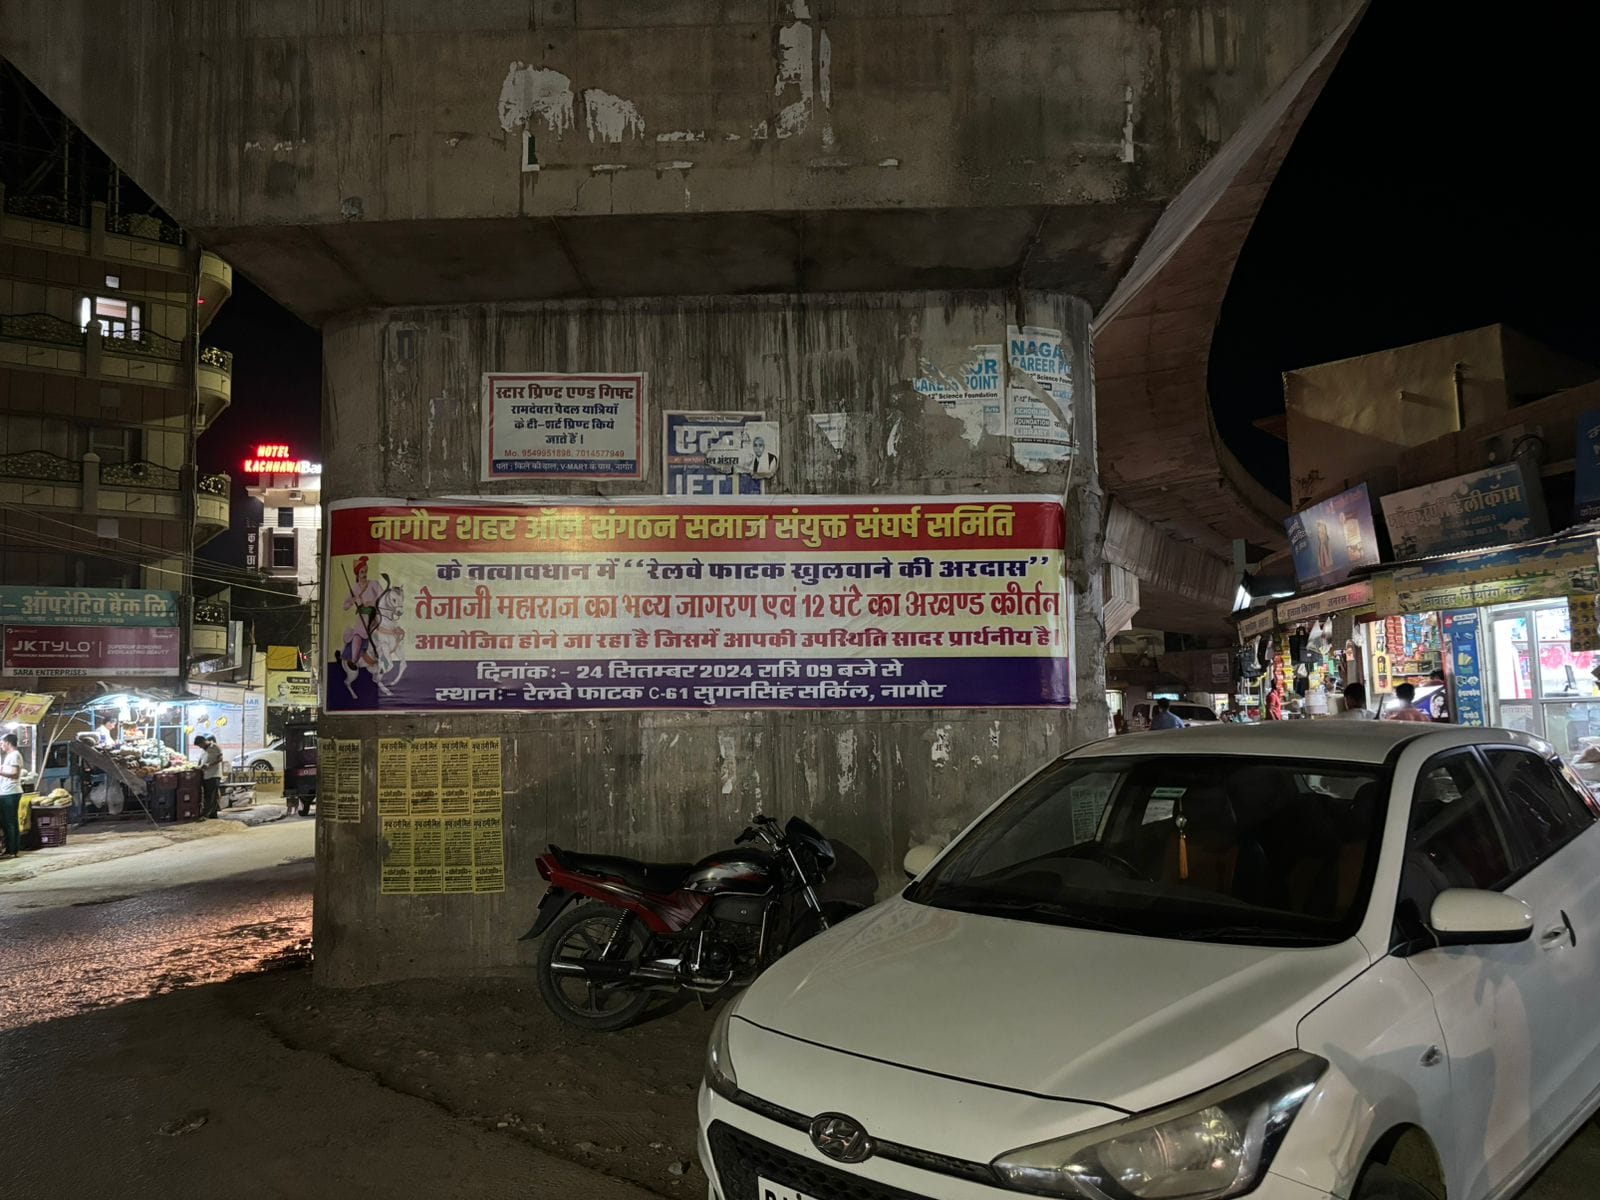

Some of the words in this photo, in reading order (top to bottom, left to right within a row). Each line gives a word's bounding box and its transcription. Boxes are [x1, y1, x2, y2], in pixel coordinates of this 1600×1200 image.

[1037, 374, 1058, 382] Science
[495, 386, 526, 399] स्टार
[566, 386, 597, 399] एण्ड
[598, 384, 635, 400] गिफ्ट
[511, 403, 553, 415] रामदेवरा
[554, 402, 580, 415] पैदल
[514, 418, 525, 429] के
[1014, 418, 1050, 426] FOUNDATION
[545, 433, 567, 445] जाते
[257, 445, 290, 458] HOTEL
[369, 508, 449, 541] नागौर
[455, 514, 519, 541] शहर
[525, 508, 586, 541] ऑल
[590, 508, 680, 540] संगठन
[684, 514, 768, 540] समाज
[773, 507, 850, 548] संयुक्त
[853, 506, 923, 540] संघर्ष
[925, 504, 1016, 539] समिति
[436, 558, 463, 581] के
[467, 562, 591, 581] तत्वावधान
[596, 557, 620, 580] में
[709, 561, 785, 580] फाटक
[790, 557, 895, 585] खुलवाने
[899, 556, 933, 579] की
[108, 592, 141, 617] बैंक
[144, 593, 175, 618] लि.
[414, 585, 491, 621] तेजाजी
[496, 594, 581, 620] महाराज
[584, 594, 619, 619] का
[622, 593, 670, 619] भव्य
[675, 593, 758, 619] जागरण
[761, 587, 798, 619] एवं
[802, 594, 825, 618] 12
[829, 584, 864, 617] घंटे
[867, 593, 901, 617] का
[905, 592, 986, 616] अखण्ड
[990, 580, 1060, 617] कीर्तन
[13, 640, 91, 652] JKTYLO
[414, 629, 513, 650] आयोजित
[518, 628, 560, 650] होने
[563, 632, 596, 650] जा
[599, 631, 632, 649] रहा
[635, 627, 651, 649] है
[654, 627, 721, 649] जिसमें
[723, 627, 798, 648] आपकी
[801, 627, 887, 647] उपस्थिति
[891, 631, 944, 647] सादर
[948, 627, 1034, 646] प्रार्थनीय
[576, 666, 604, 679] 24
[608, 660, 696, 679] सितम्बर
[697, 664, 753, 678] 2024
[757, 658, 803, 679] रात्रि
[806, 664, 831, 678] 09
[836, 659, 880, 678] बजे
[881, 658, 905, 678] से
[522, 682, 573, 702] रेलवे
[577, 685, 644, 700] फाटक
[649, 687, 688, 700] C-61
[693, 681, 794, 705] सुगनसिंह
[797, 680, 876, 702] सर्किल,
[880, 680, 947, 699] नागौर
